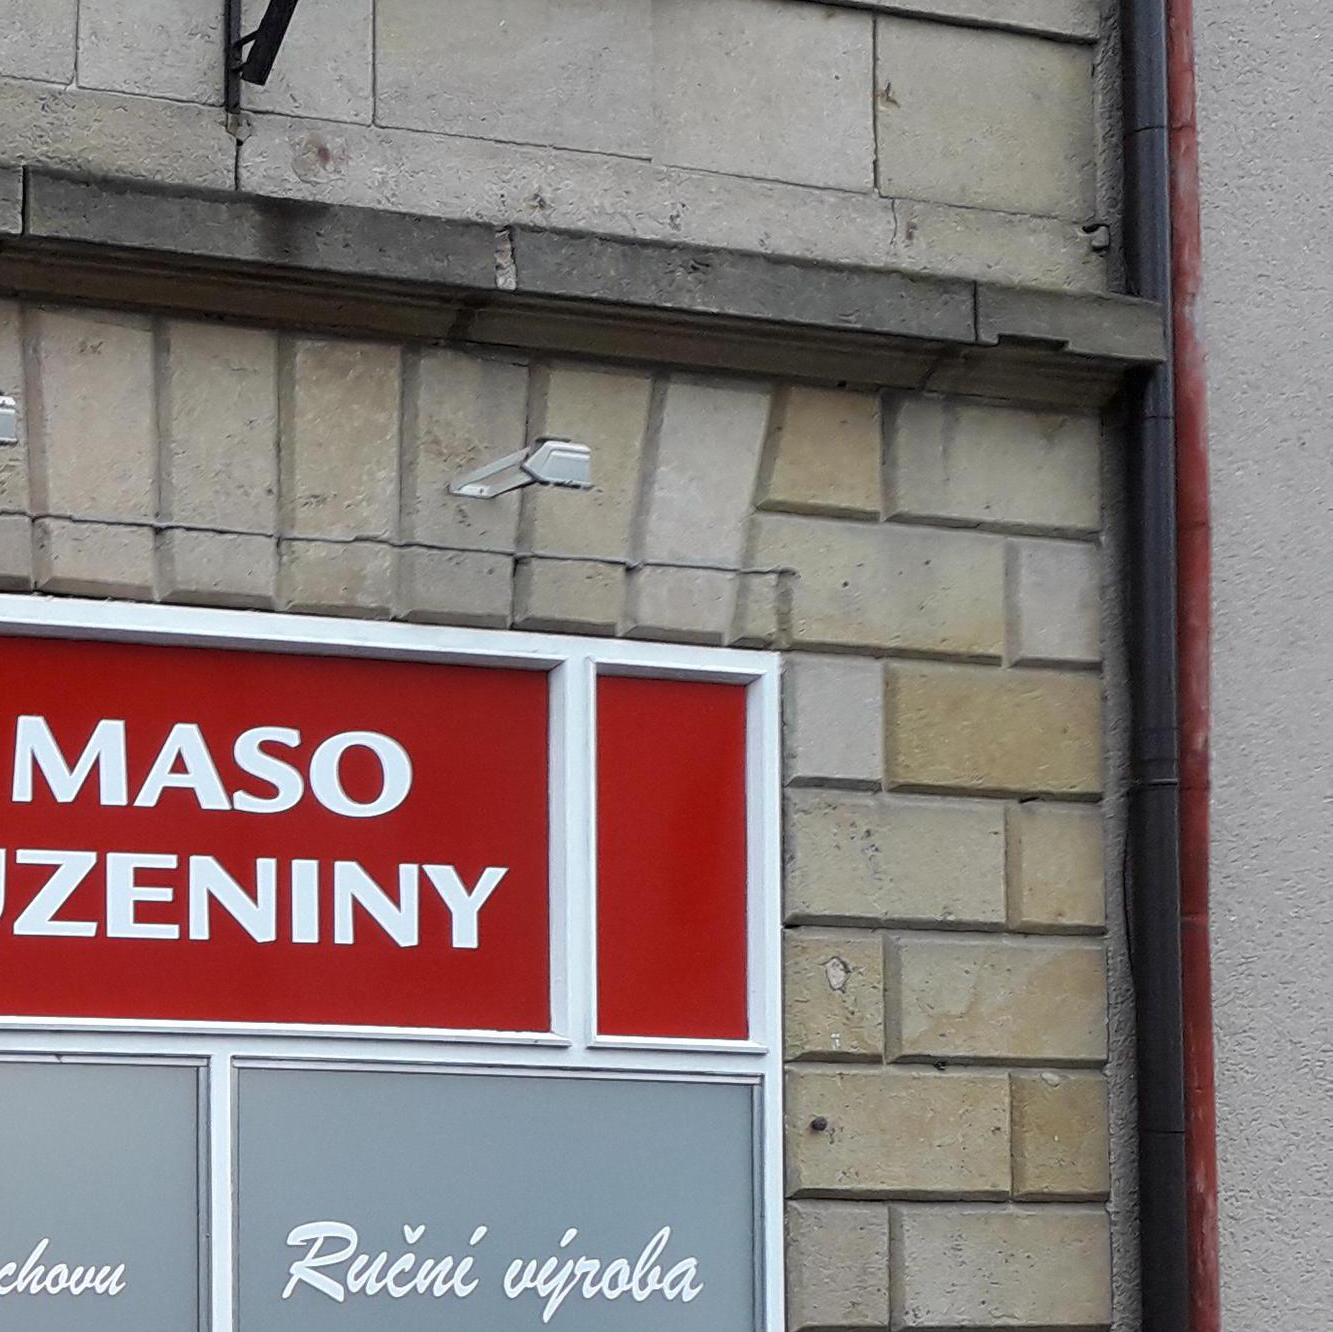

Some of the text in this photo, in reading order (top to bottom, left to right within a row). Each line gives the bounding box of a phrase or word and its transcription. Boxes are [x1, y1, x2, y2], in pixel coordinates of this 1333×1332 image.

[11, 714, 414, 818] MASO
[281, 1220, 705, 1324] Ruční výroba
